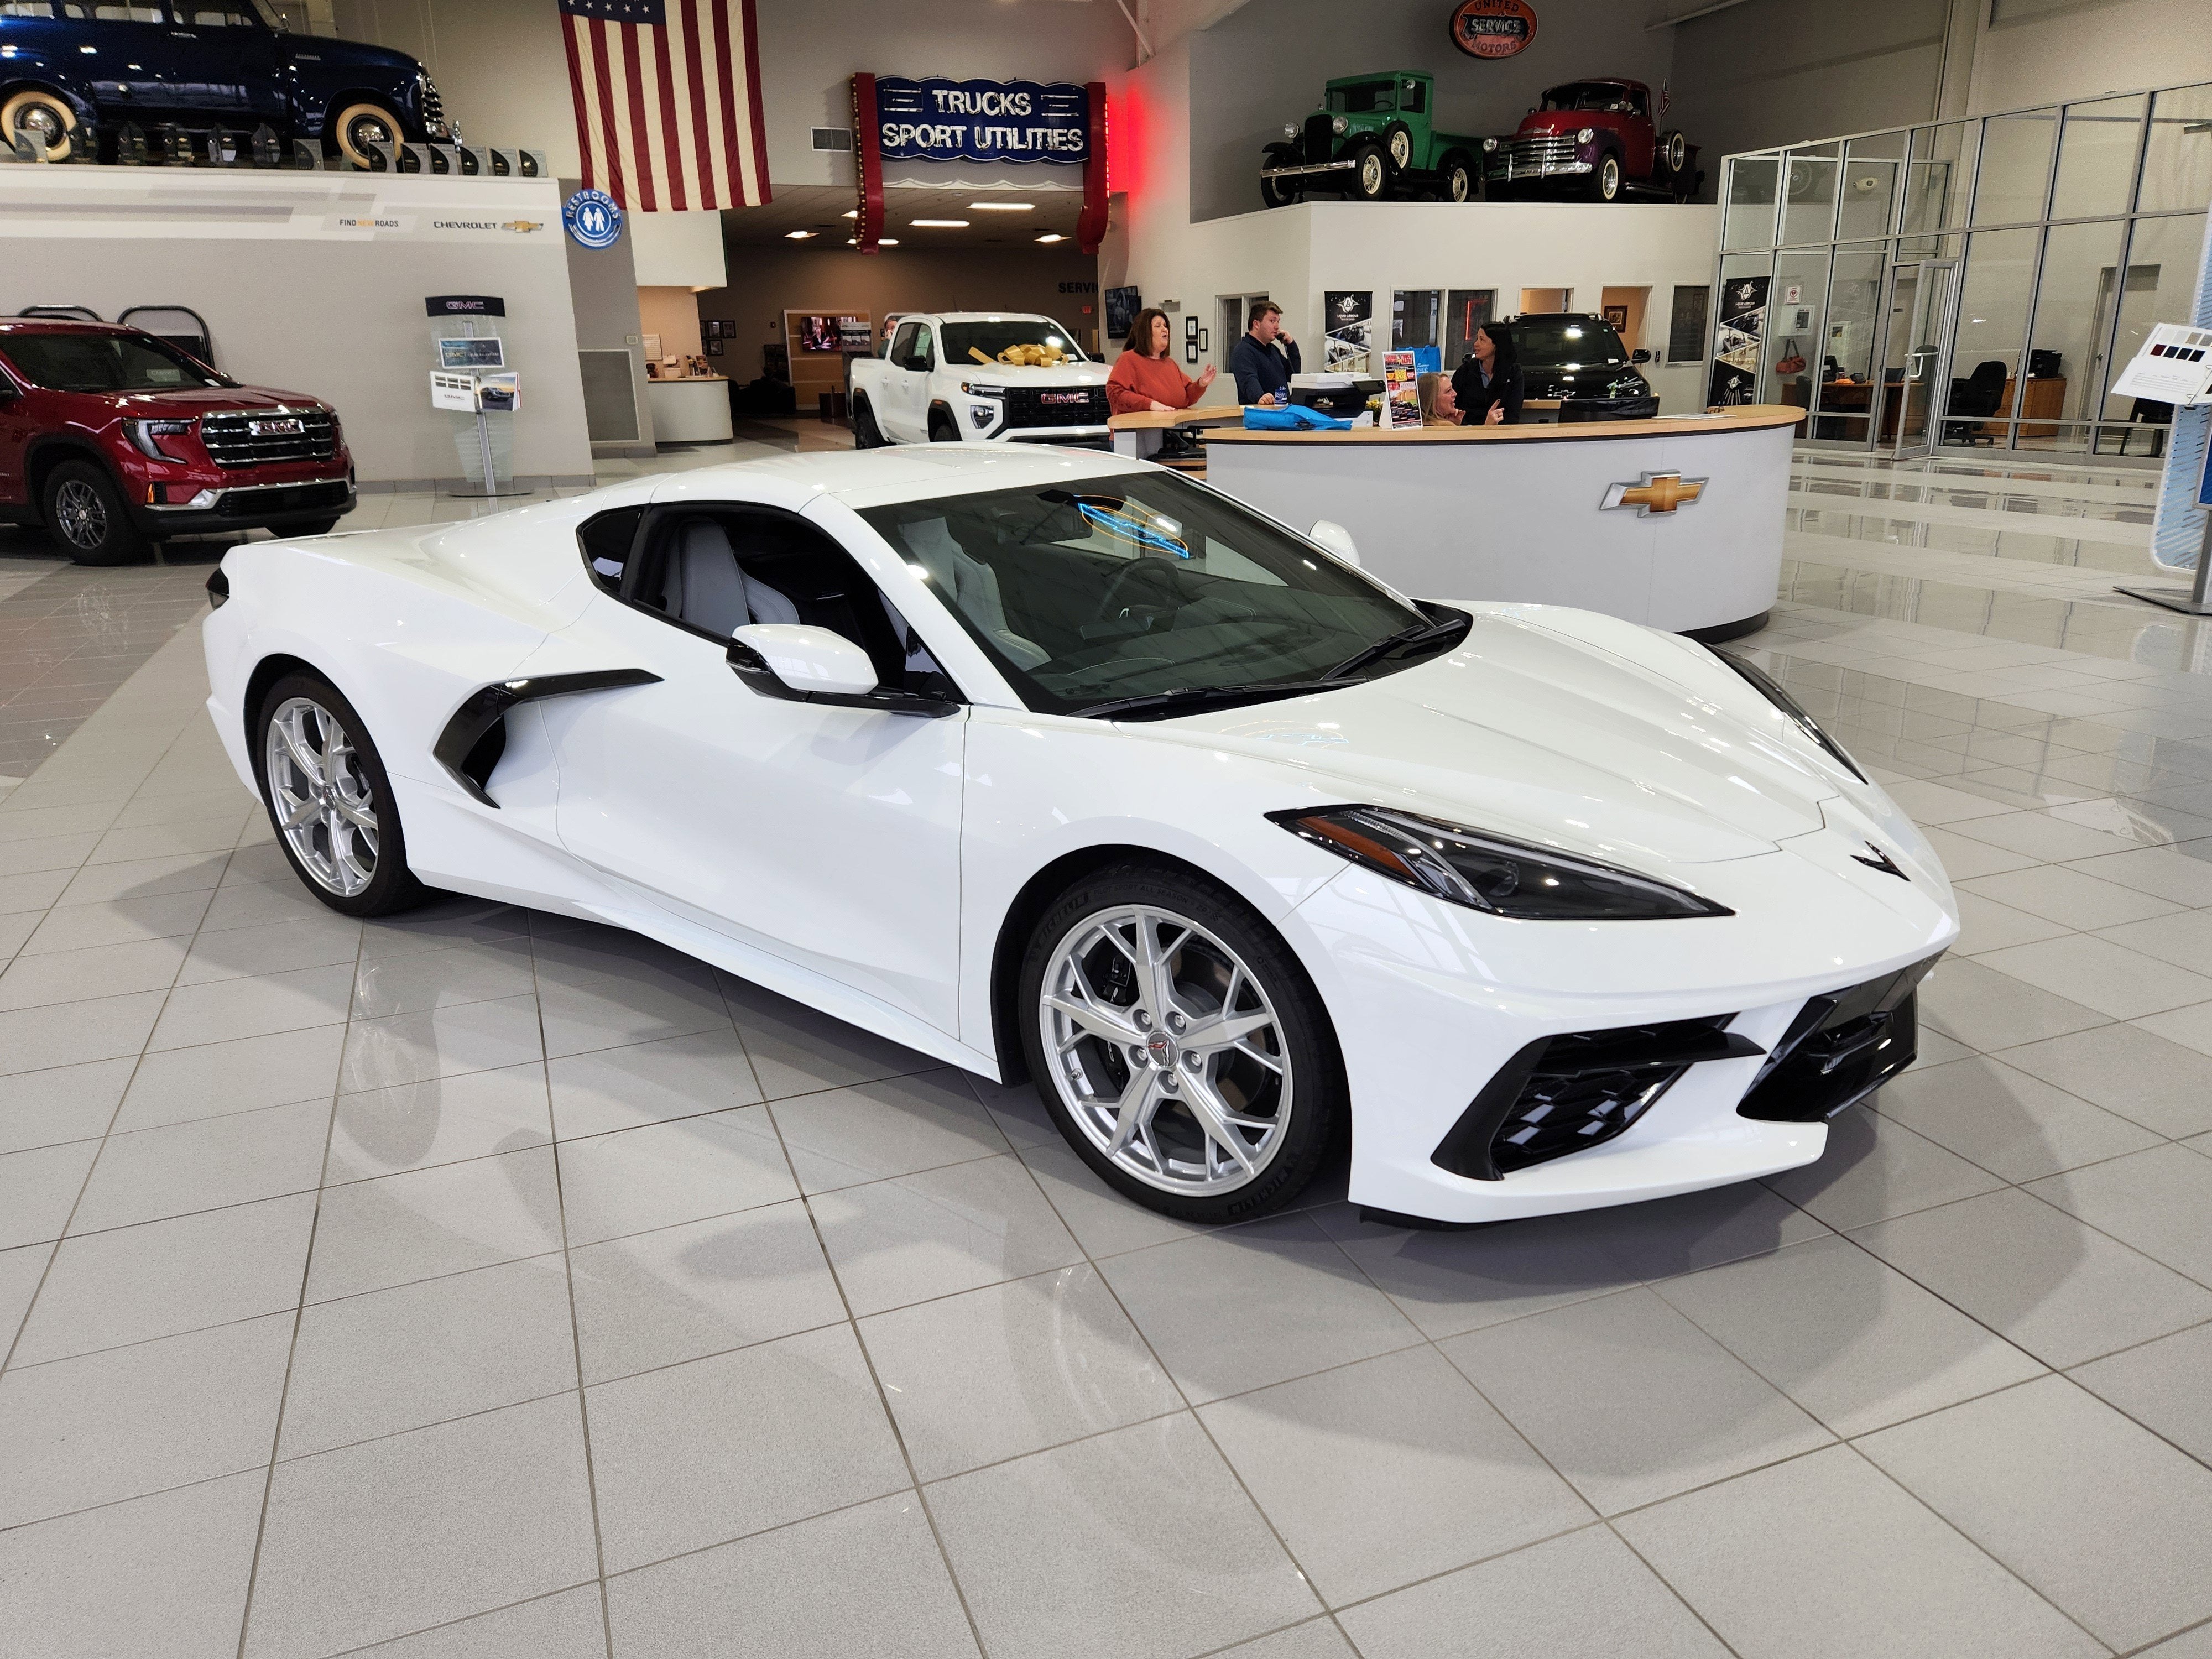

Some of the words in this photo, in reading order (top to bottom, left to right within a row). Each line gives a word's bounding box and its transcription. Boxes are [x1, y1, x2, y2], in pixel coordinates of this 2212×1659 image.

[1475, 0, 1519, 12] UNITED
[1471, 19, 1520, 33] SERVICE
[1472, 41, 1517, 53] MOTORS
[932, 90, 1032, 116] TRUCKS
[882, 123, 967, 148] SPORT
[974, 126, 1084, 151] UTILITIES
[566, 191, 620, 219] RESTROOMS
[434, 221, 497, 229] CHEVROLET
[1041, 392, 1089, 404] GMC
[252, 420, 304, 435] GMC
[1156, 888, 1188, 904] SEASON
